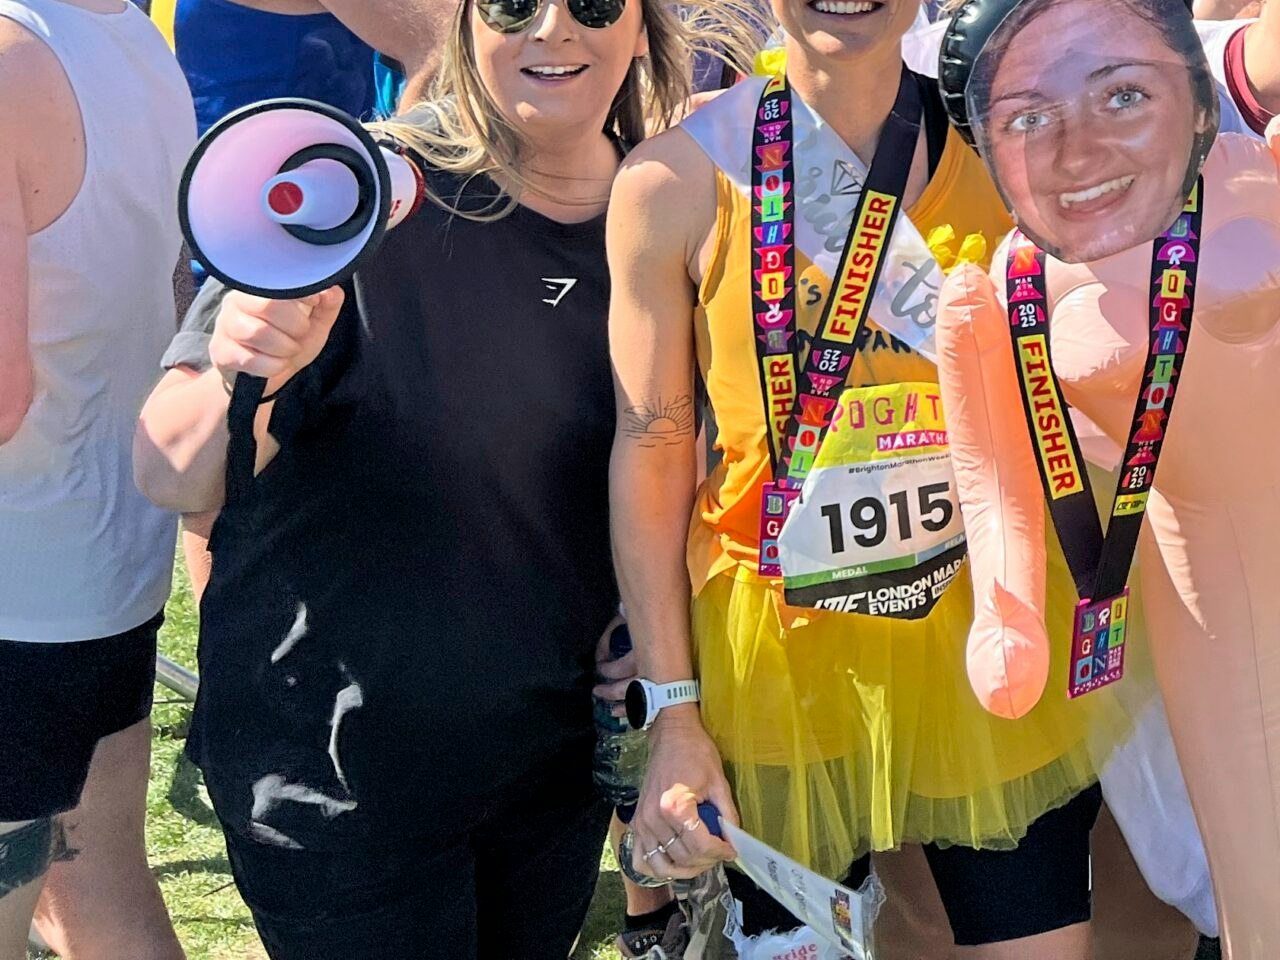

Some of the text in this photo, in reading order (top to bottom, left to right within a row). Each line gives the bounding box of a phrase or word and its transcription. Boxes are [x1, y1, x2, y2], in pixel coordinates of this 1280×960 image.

[829, 197, 892, 337] FINISHER
[769, 359, 791, 434] SHER
[1023, 341, 1075, 493] FINISHER
[820, 482, 954, 554] 1915
[832, 565, 868, 581] MEDAL
[867, 576, 933, 604] LONDON
[868, 591, 928, 616] EVENTS
